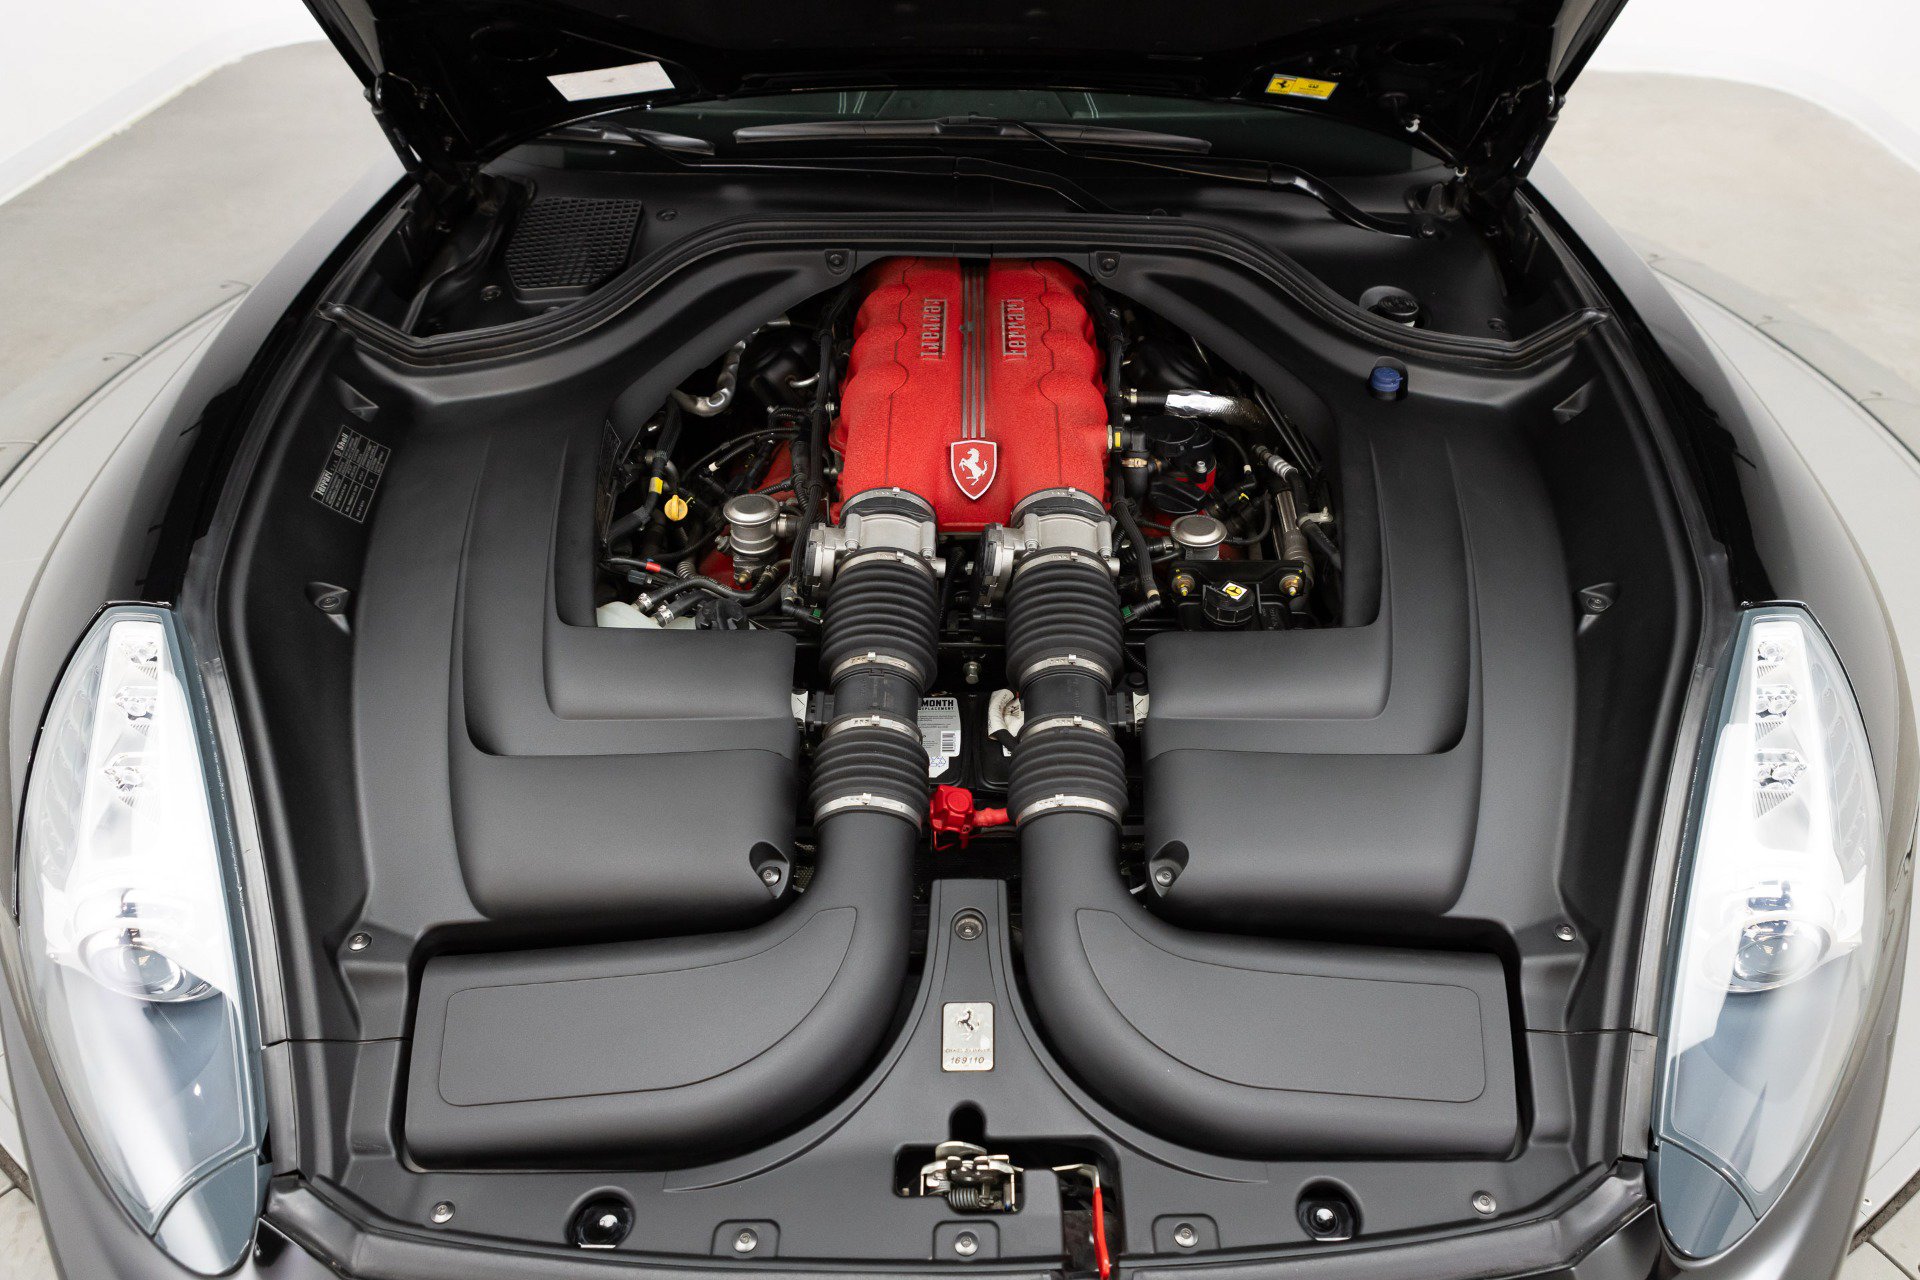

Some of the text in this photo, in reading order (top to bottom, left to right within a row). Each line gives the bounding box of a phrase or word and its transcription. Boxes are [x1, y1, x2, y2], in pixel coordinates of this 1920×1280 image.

[920, 298, 947, 357] Ferrari
[1001, 298, 1028, 357] Ferrari
[315, 432, 350, 496] Ferrari Shell
[921, 699, 954, 707] MONTH
[951, 1056, 985, 1065] 169110
